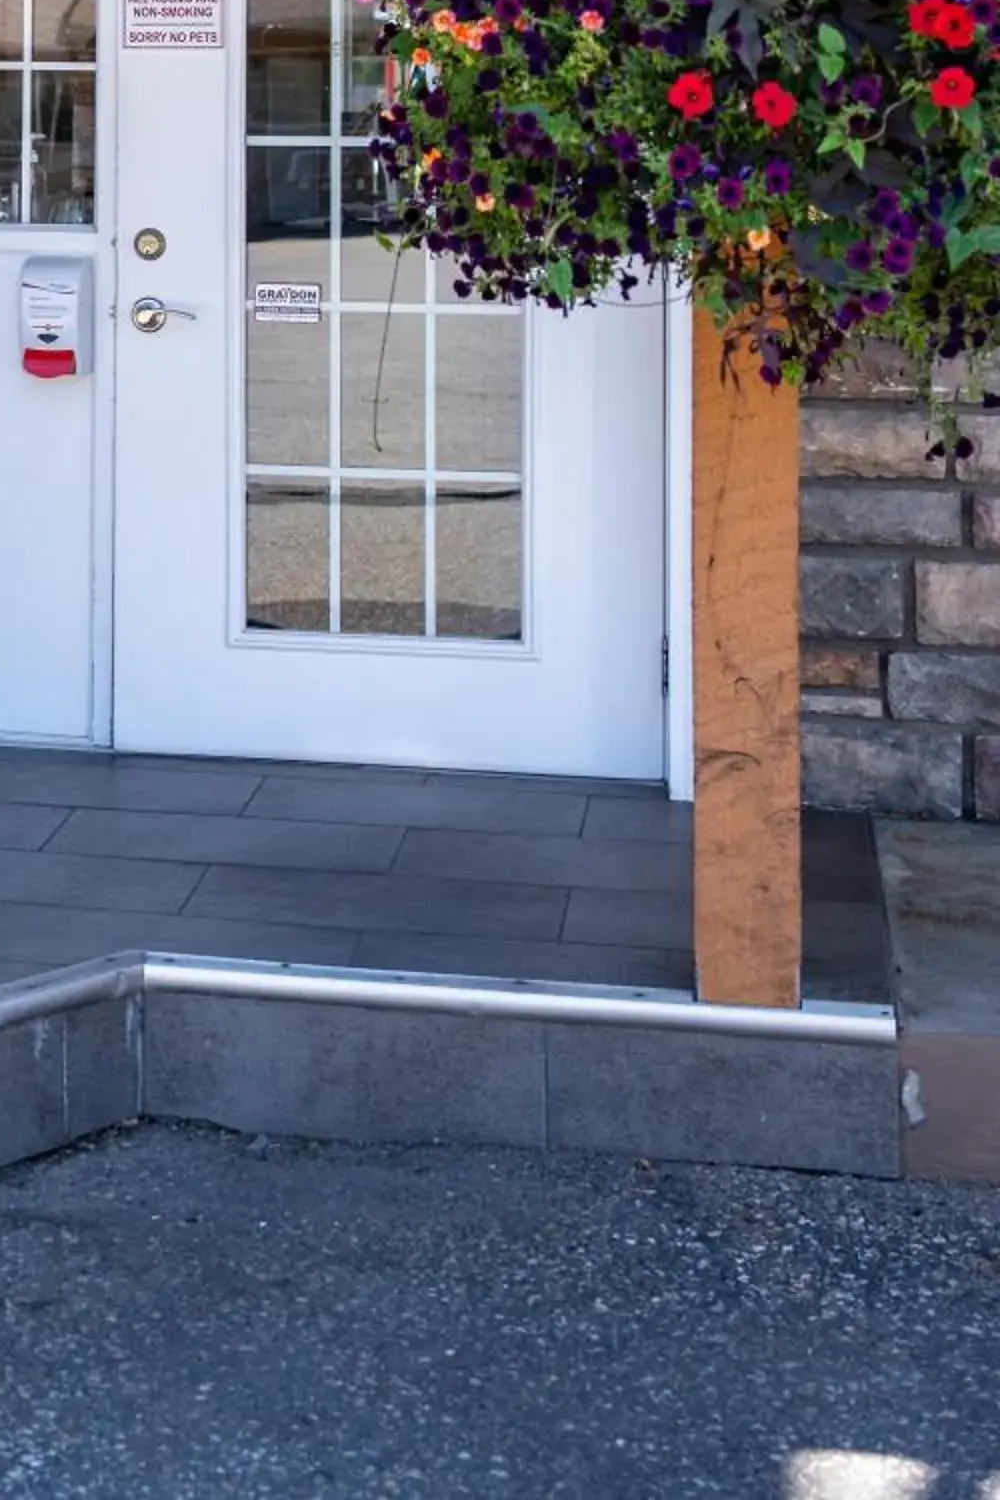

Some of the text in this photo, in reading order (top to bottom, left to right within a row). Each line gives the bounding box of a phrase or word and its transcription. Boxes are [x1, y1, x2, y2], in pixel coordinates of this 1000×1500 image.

[133, 6, 213, 18] NON-SMOKING
[129, 31, 217, 43] SORRY NO PETS
